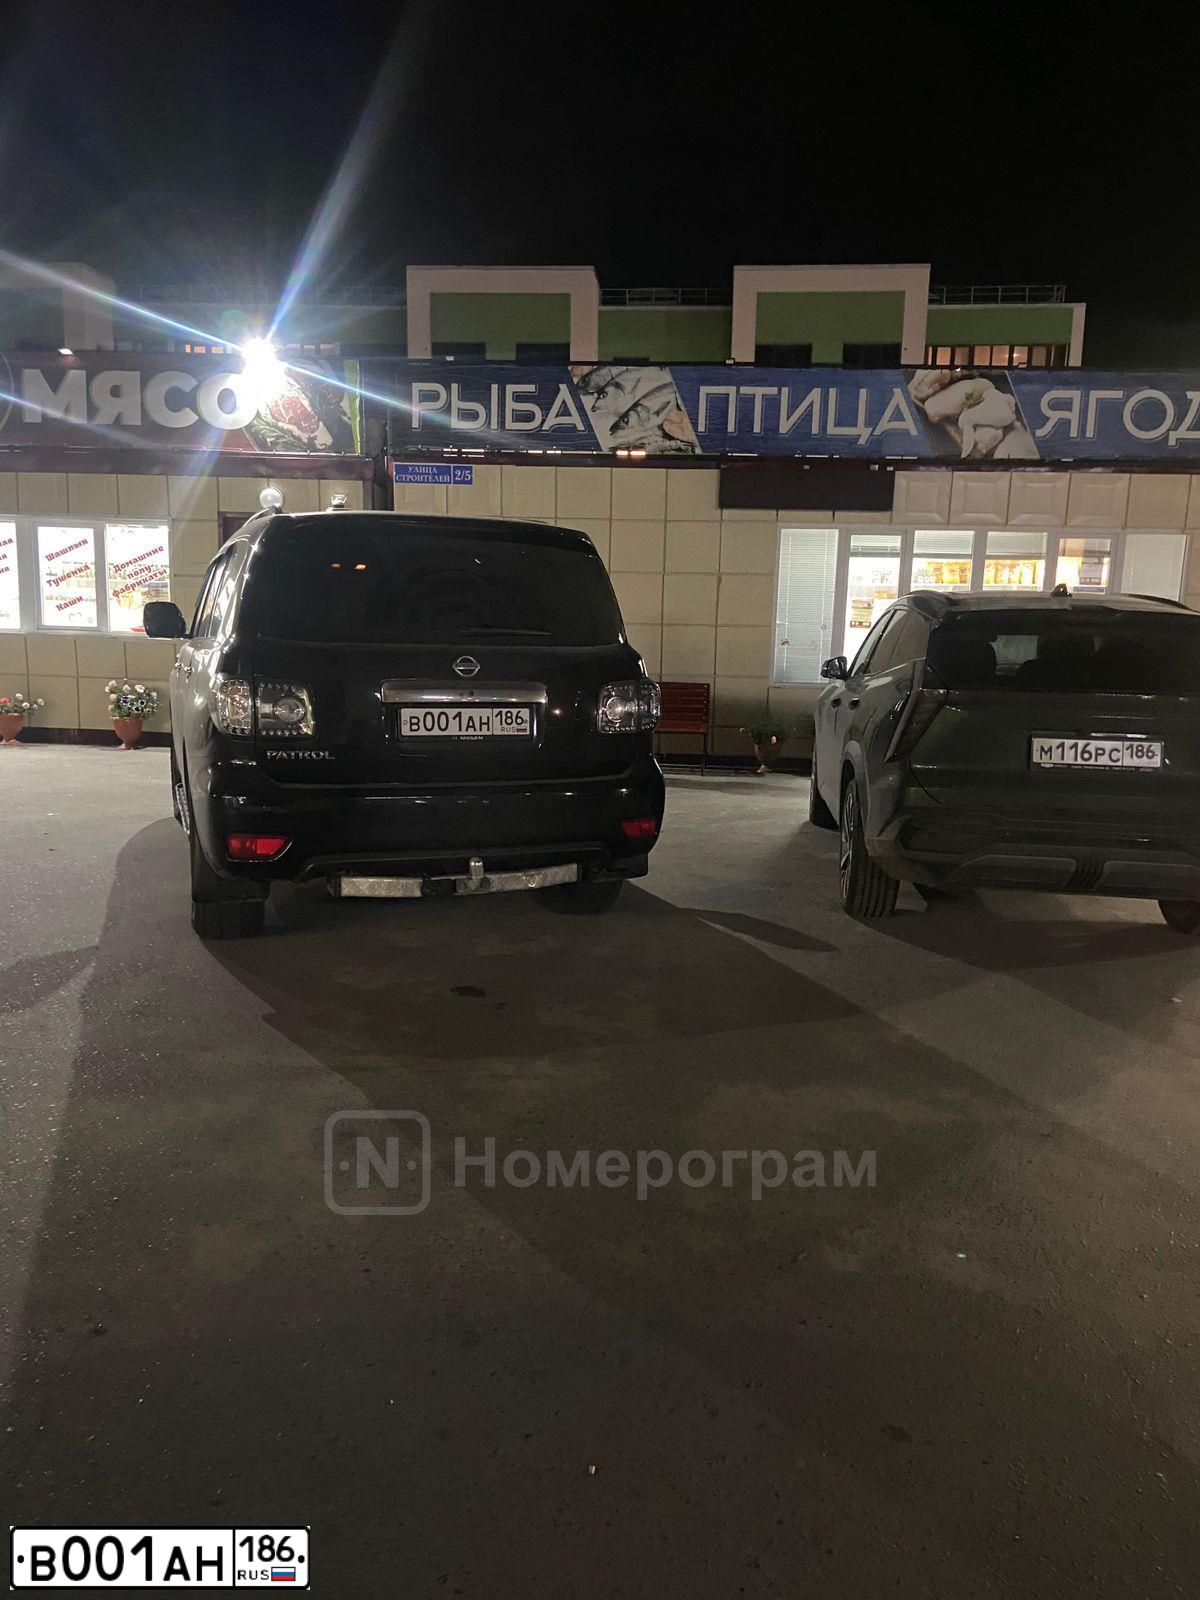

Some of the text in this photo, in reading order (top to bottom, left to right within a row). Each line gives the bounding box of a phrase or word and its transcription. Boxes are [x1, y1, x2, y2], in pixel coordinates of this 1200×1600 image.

[22, 368, 260, 430] МЯСО
[411, 382, 584, 433] РЫБА
[698, 385, 919, 446] ПТИЦА
[1036, 389, 1200, 446] ЯГОД
[396, 474, 450, 483] СТРОИТЕЛЕЙ
[408, 466, 438, 474] УЛИЦА
[455, 468, 471, 481] 2/5
[114, 545, 164, 573] Домашние
[56, 596, 84, 611] Каши
[409, 710, 524, 732] В001АН 186
[266, 750, 336, 760] PATROL
[1039, 741, 1155, 763] М116РС 186
